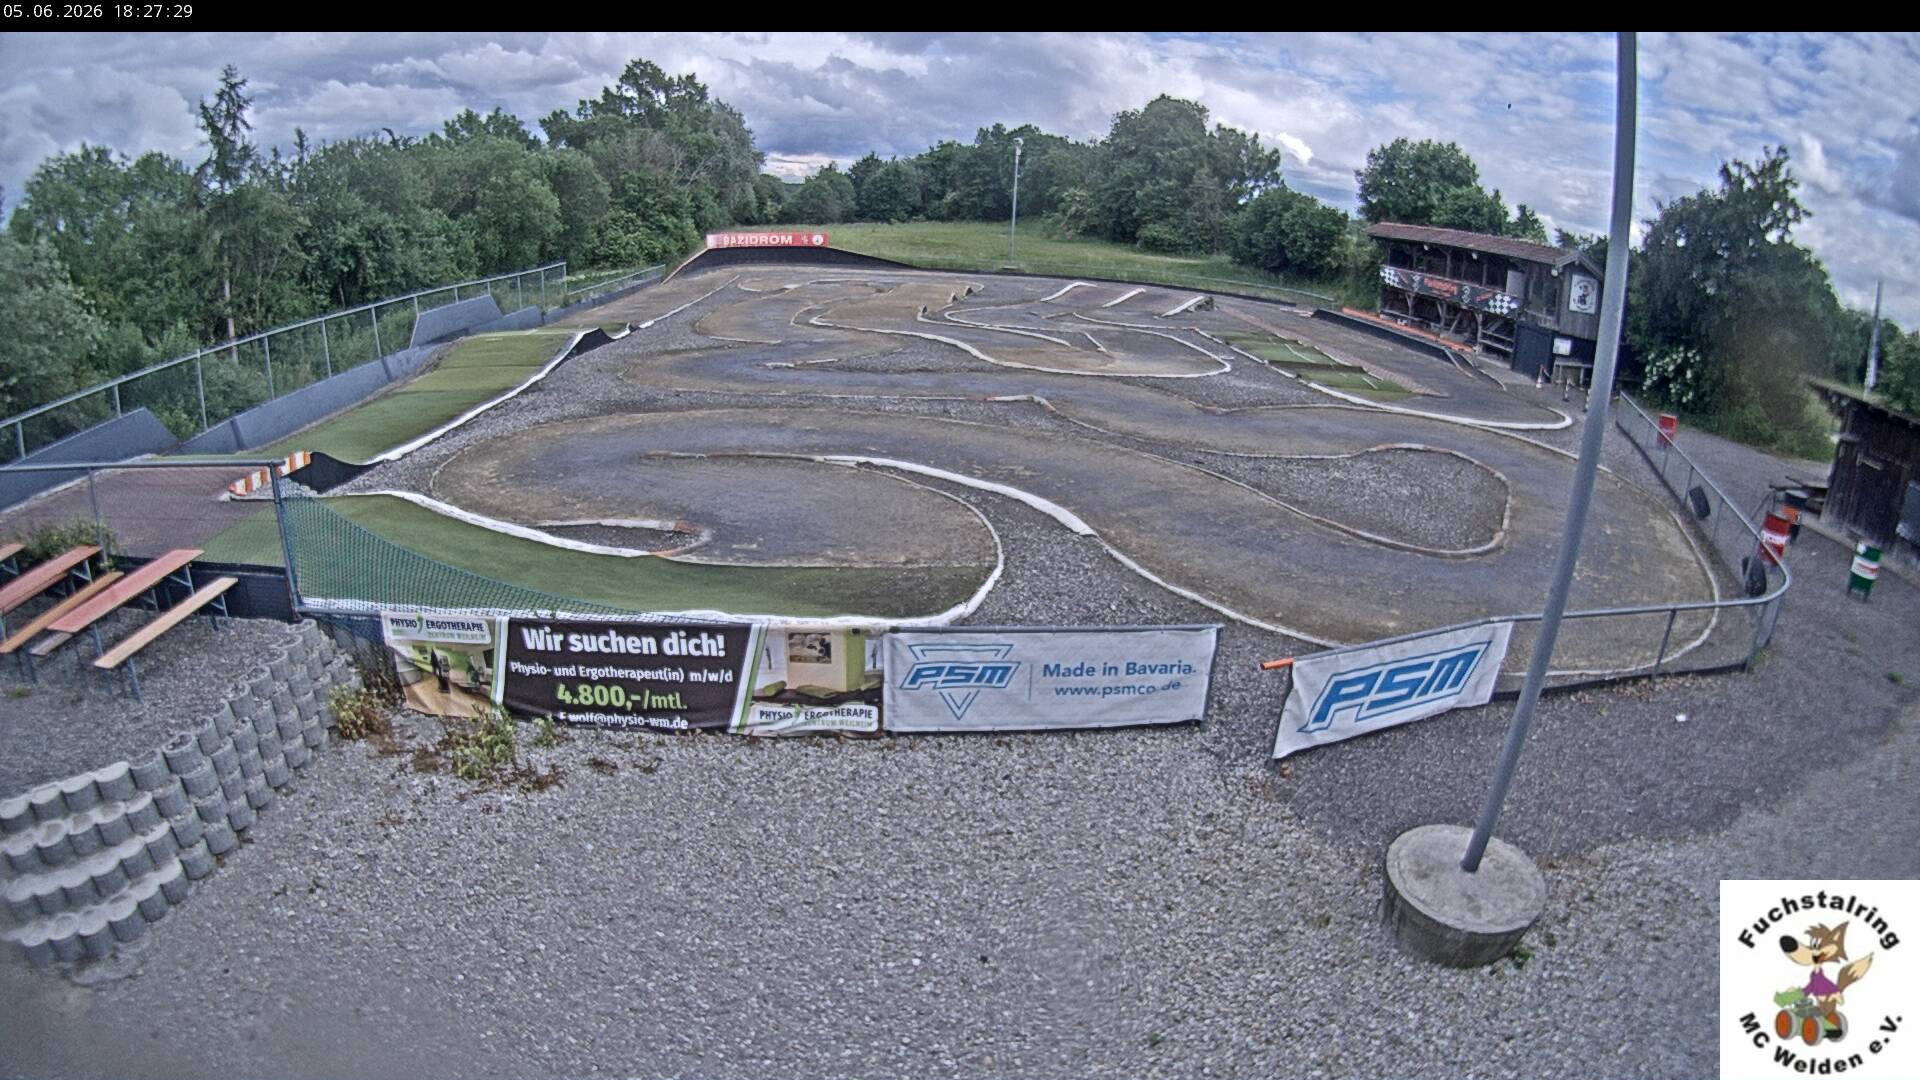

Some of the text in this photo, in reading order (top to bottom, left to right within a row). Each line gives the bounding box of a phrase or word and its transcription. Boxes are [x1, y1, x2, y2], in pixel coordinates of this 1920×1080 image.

[390, 617, 485, 632] PHYSIO ERGOTHERAPIE
[521, 625, 726, 658] Wir suchen dich!
[509, 661, 734, 683] Physio- und Ergotherapeut(in) m/w/d
[907, 665, 1013, 686] PSM
[1043, 659, 1198, 678] Made in Bavaria.
[1053, 679, 1182, 699] www.psmco.de
[1309, 646, 1486, 724] PSM
[760, 709, 793, 720] PHYSIO
